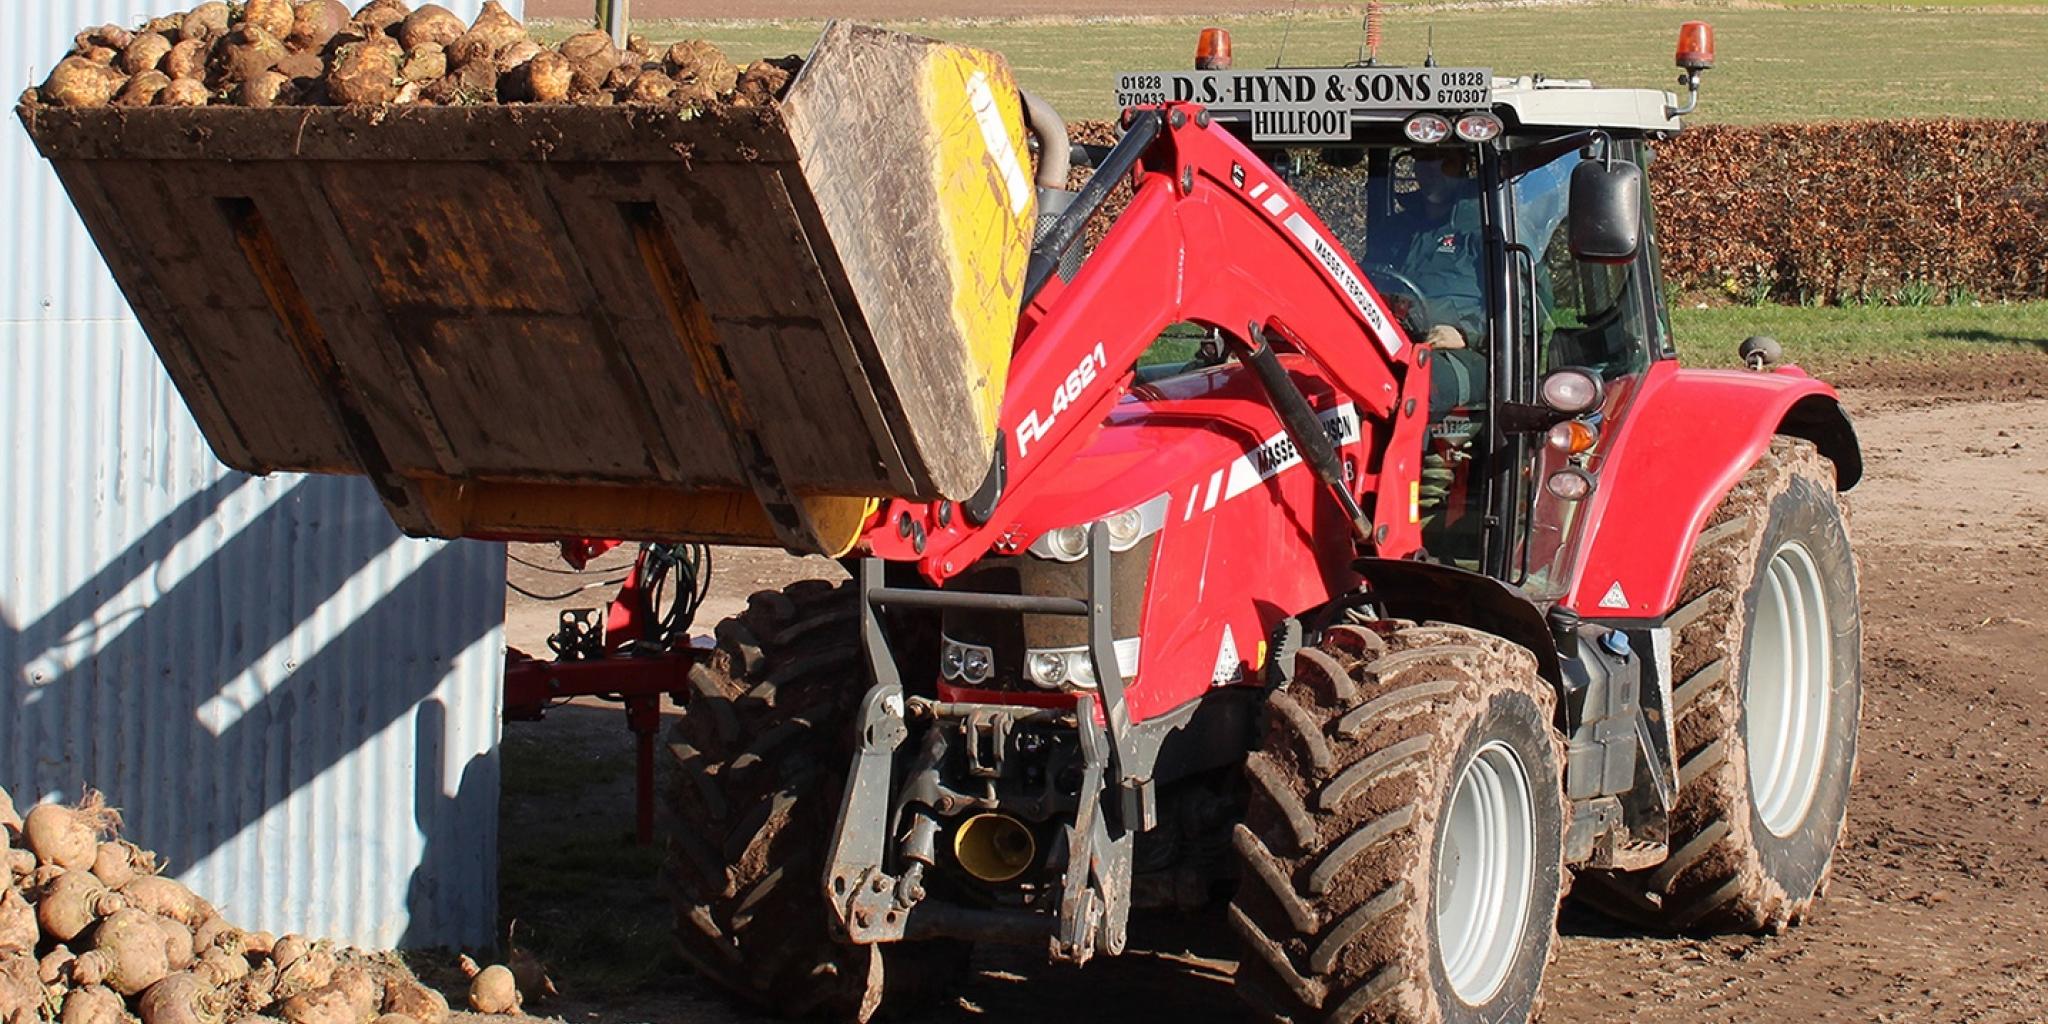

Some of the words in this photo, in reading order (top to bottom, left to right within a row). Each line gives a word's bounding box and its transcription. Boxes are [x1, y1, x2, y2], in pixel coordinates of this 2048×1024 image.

[1121, 76, 1162, 90] 01828
[1172, 76, 1224, 103] D.S.
[1232, 75, 1316, 102] HYND
[1325, 74, 1346, 102] &
[1354, 74, 1431, 102] SONS
[1441, 72, 1483, 86] 01828
[1118, 93, 1165, 106] 670433
[1437, 89, 1487, 103] 670307
[1254, 110, 1348, 135] HILLFOOT
[1314, 238, 1345, 280] MASSEY
[1344, 275, 1383, 331] FERGUSON
[1256, 437, 1295, 475] MASSE
